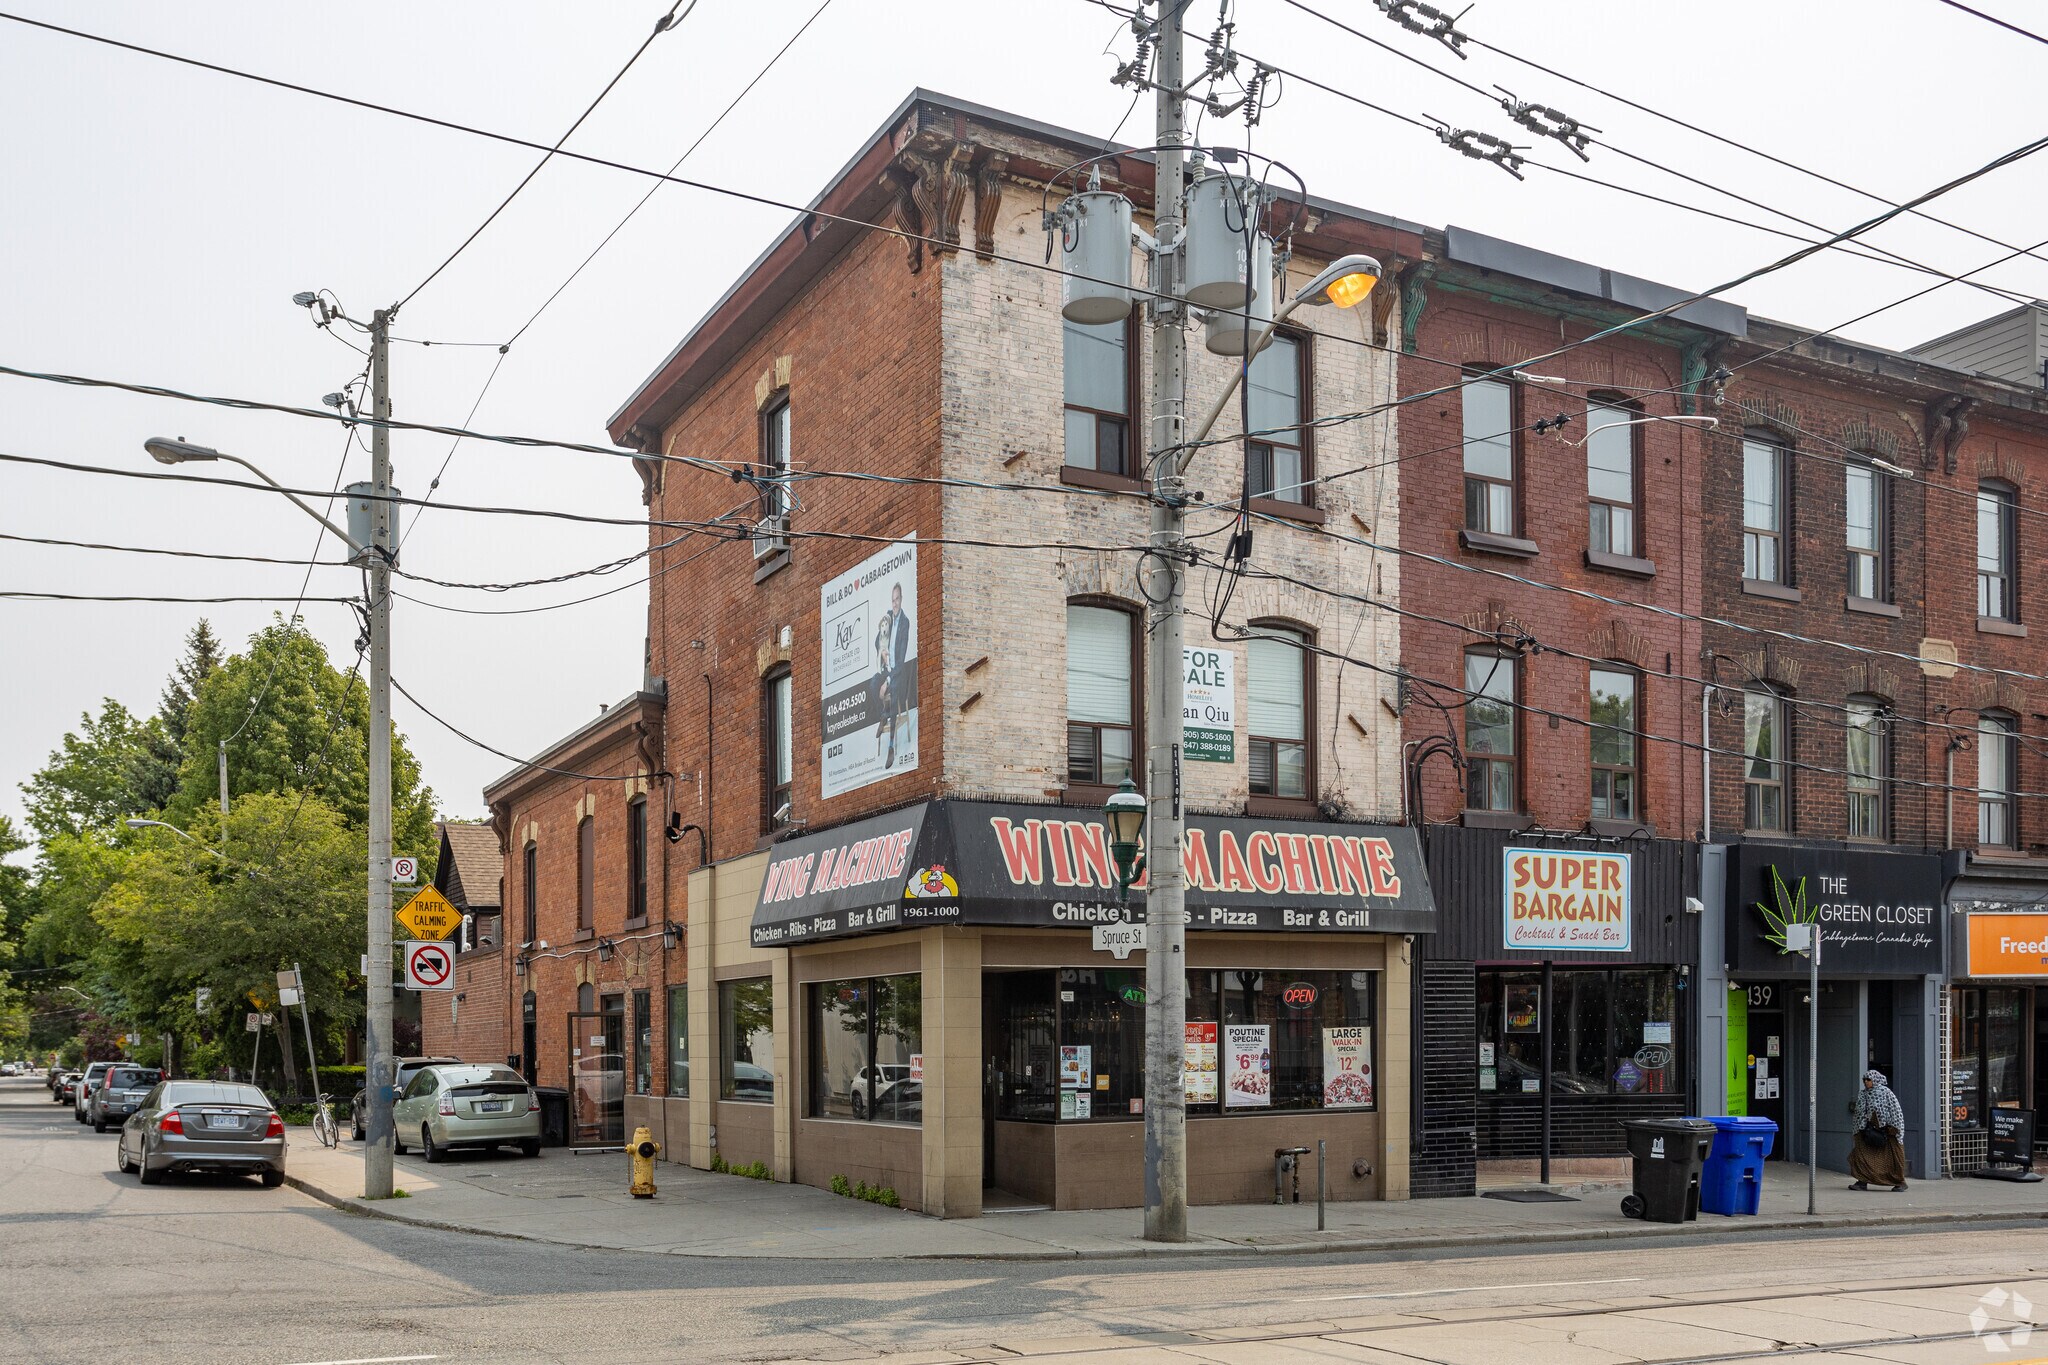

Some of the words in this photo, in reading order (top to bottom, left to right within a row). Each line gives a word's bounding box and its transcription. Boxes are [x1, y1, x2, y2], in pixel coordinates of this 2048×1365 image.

[826, 592, 838, 608] BILL
[838, 589, 844, 601] &
[844, 584, 854, 598] BO
[860, 549, 912, 588] CABBAGETOWN
[834, 618, 860, 650] Kay
[1183, 668, 1225, 688] ALE
[826, 691, 866, 717] 416.429.5500
[826, 711, 866, 735] kayrealestate.ca
[1205, 706, 1230, 722] Qiu
[1200, 732, 1232, 742] 305-1600
[1200, 742, 1231, 752] 388-0189
[762, 852, 815, 904] WING
[810, 828, 912, 894] MACHINE
[1513, 856, 1622, 892] SUPER
[1820, 876, 1848, 895] THE
[415, 901, 445, 912] TRAFFIC
[909, 906, 960, 917] 961-1000
[1052, 902, 1131, 922] Chicken
[1513, 891, 1622, 922] BARGAIN
[1820, 904, 1871, 922] GREEN
[1876, 906, 1934, 924] CLOSET
[414, 915, 446, 926] CALMING
[753, 924, 782, 942] Chicken
[789, 922, 807, 937] Ribs
[814, 917, 836, 933] Pizza
[848, 912, 865, 927] Bar
[866, 912, 874, 924] &
[876, 905, 896, 922] Grill
[1210, 907, 1257, 926] Pizza
[1283, 909, 1313, 926] Bar
[1318, 910, 1331, 926] &
[1335, 910, 1369, 927] Grill
[420, 930, 440, 940] ZONE
[1102, 930, 1130, 948] Spruce
[1133, 929, 1141, 943] St
[1514, 925, 1555, 941] Cocktail
[1559, 926, 1566, 939] &
[1570, 928, 1599, 940] Snack
[1603, 928, 1620, 940] Bar
[1875, 932, 1912, 944] Cannabis
[1912, 932, 1933, 948] Shop
[2000, 936, 2048, 954] Freed
[1284, 989, 1315, 1003] OPEN
[1509, 1015, 1537, 1025] KARAOKE
[1332, 1029, 1361, 1038] LARGE
[1636, 1051, 1668, 1063] OPEN
